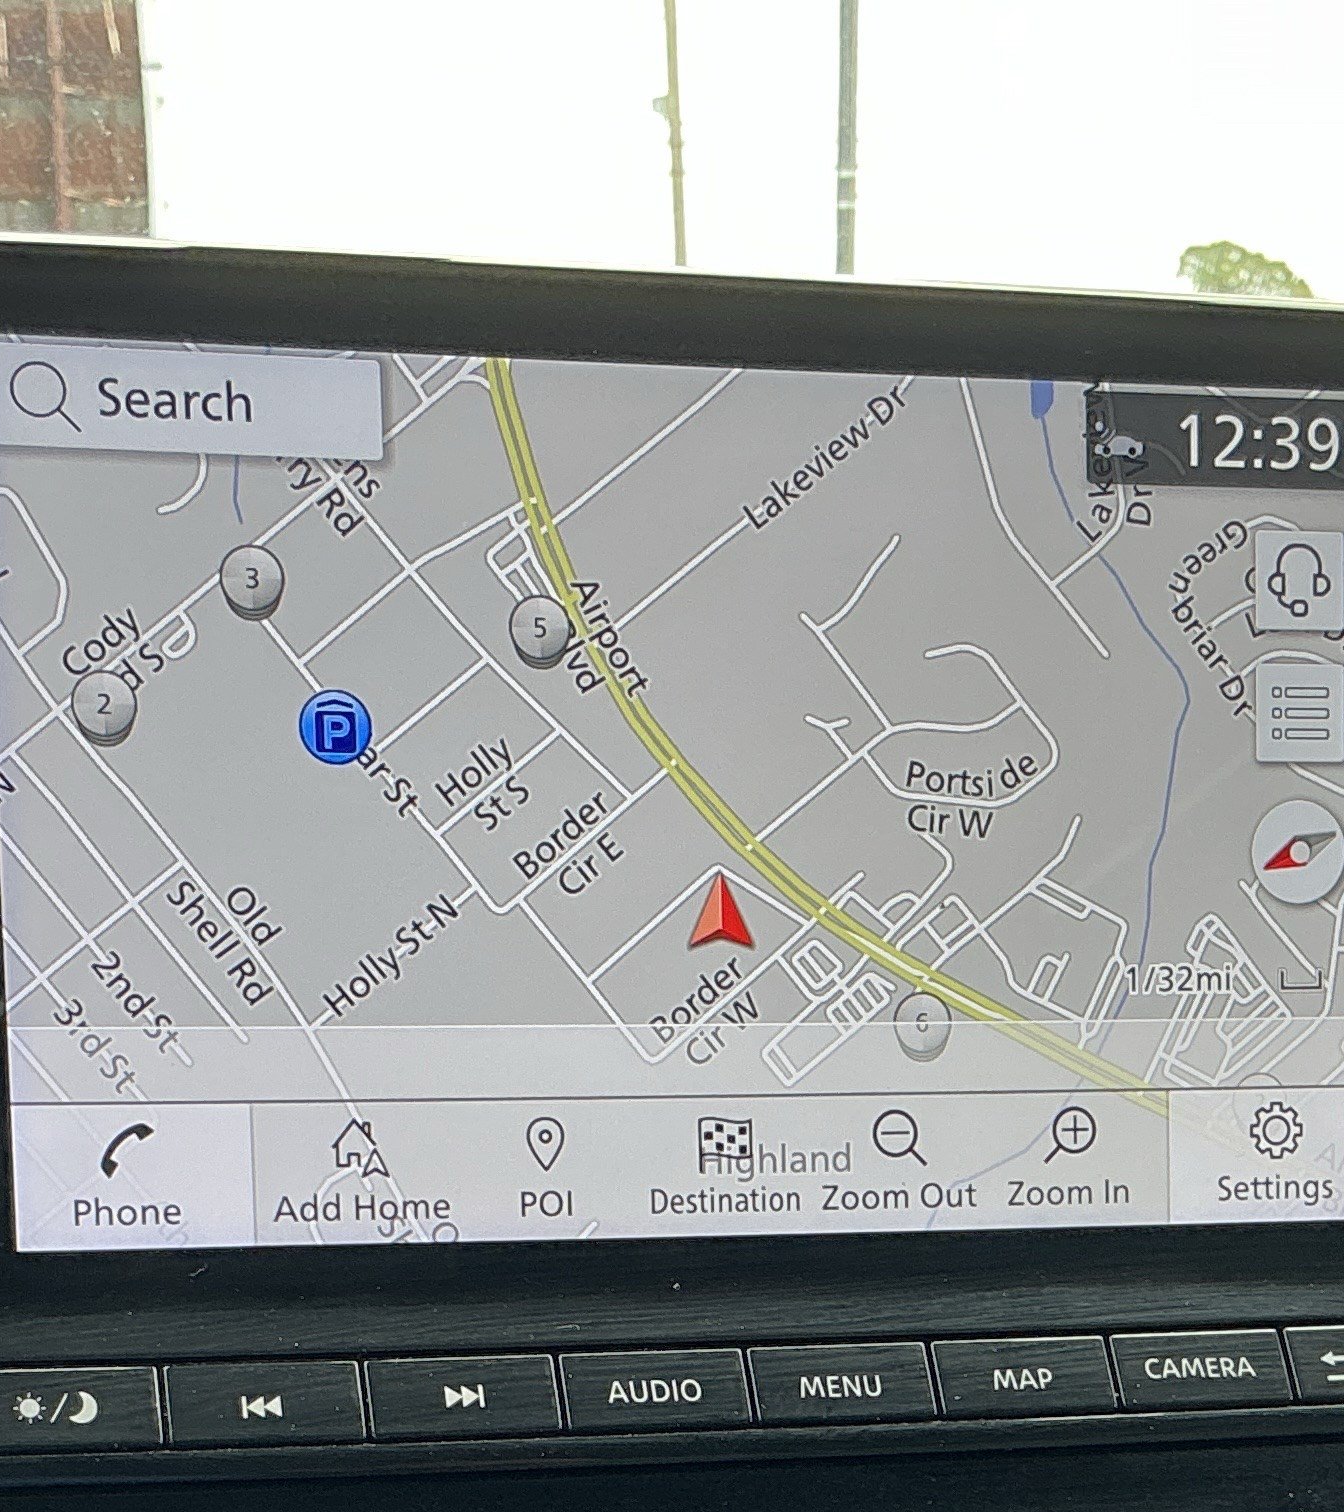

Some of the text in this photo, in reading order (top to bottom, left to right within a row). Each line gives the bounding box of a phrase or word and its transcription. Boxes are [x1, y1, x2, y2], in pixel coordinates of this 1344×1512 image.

[96, 377, 254, 423] Search
[742, 385, 907, 531] Lakeview Dr
[1179, 413, 1340, 472] 12:39
[315, 486, 366, 537] Rd
[245, 567, 259, 590] 3
[62, 607, 142, 676] Cody
[533, 616, 547, 639] 5
[570, 582, 649, 699] Airport
[139, 643, 164, 673] S
[96, 693, 112, 715] 2
[1218, 674, 1253, 717] Dr
[434, 738, 513, 808] Holly
[383, 777, 419, 819] St
[473, 775, 530, 832] St S
[512, 792, 609, 881] Border
[907, 803, 994, 839] Cir W
[557, 833, 625, 897] Cir E
[227, 886, 283, 946] Old
[166, 880, 275, 1008] Shell Rd
[323, 894, 460, 1018] Holly St N
[1124, 964, 1236, 993] 1/32mi
[90, 950, 180, 1054] 2nd St
[648, 956, 743, 1045] Border
[52, 997, 136, 1095] 3rd St
[686, 991, 759, 1065] Cir W
[273, 1194, 452, 1223] Add Home
[519, 1190, 574, 1218] POI
[649, 1186, 801, 1215] Destination
[821, 1181, 978, 1212] Zoom Out
[1007, 1180, 1131, 1208] Zoom In
[1217, 1174, 1334, 1207] Settings
[72, 1198, 182, 1227] Phone
[798, 1373, 883, 1400] MENU
[992, 1367, 1055, 1393] MAP
[1143, 1355, 1257, 1380] CAMERA
[607, 1378, 703, 1405] AUDIO
